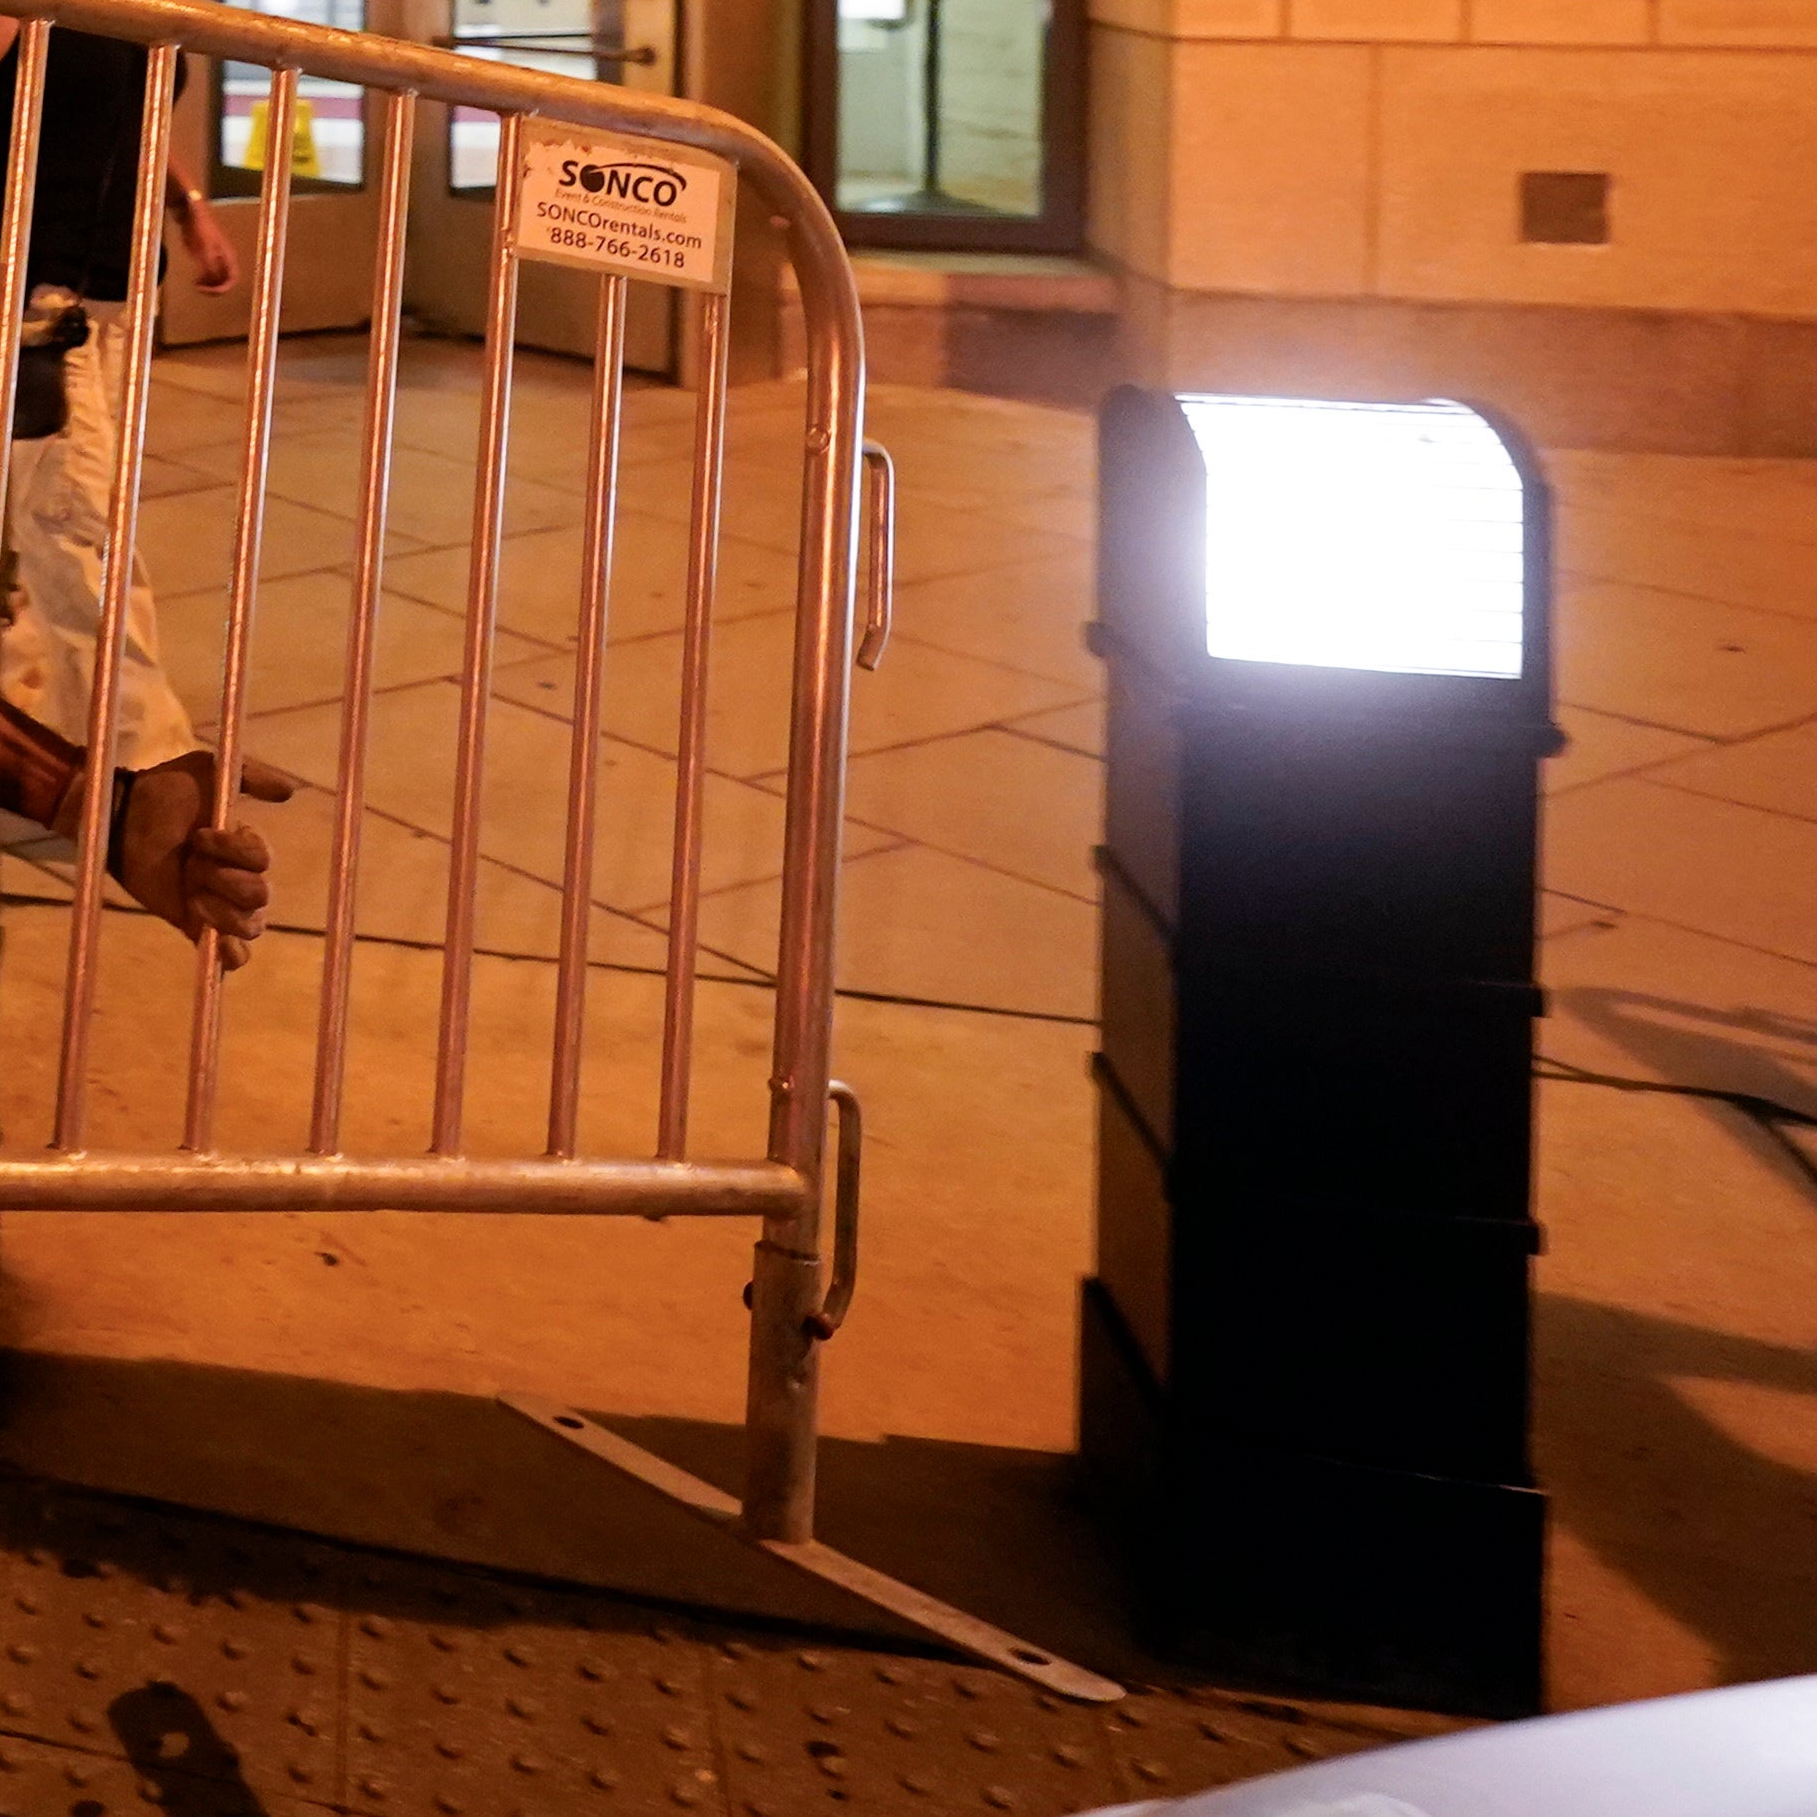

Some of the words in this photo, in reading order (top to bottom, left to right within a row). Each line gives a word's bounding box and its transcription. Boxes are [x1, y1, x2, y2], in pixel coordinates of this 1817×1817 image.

[558, 159, 678, 207] SONCO
[536, 201, 703, 250] SONCOrentals.com
[550, 226, 685, 269] 888-766-2618
